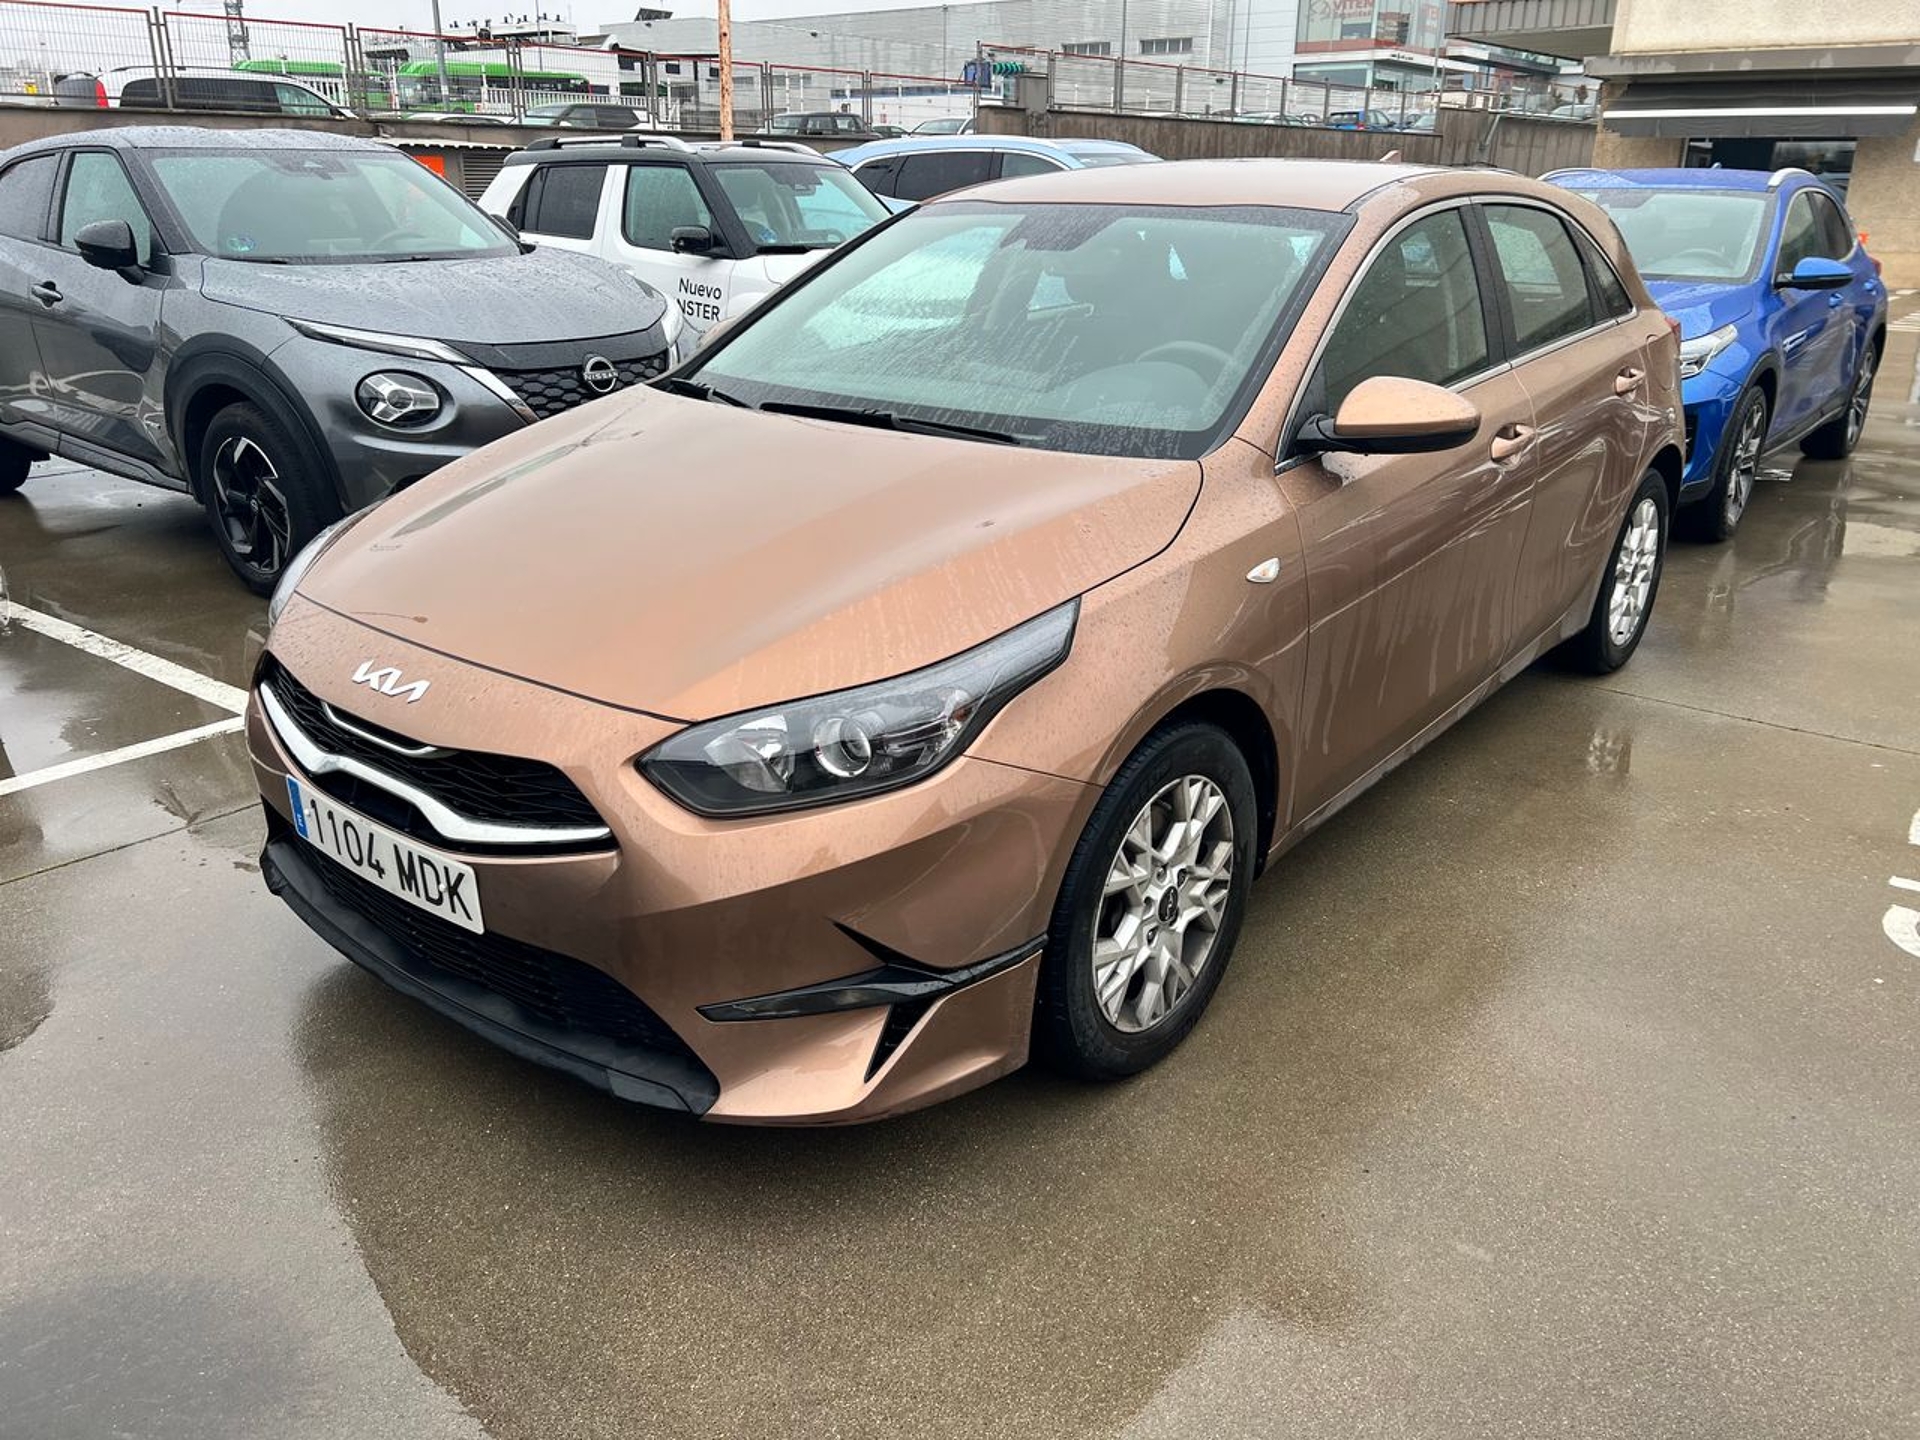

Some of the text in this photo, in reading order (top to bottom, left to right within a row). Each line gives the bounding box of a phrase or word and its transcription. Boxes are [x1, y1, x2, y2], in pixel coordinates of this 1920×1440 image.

[679, 277, 722, 300] Nuevo
[676, 298, 720, 321] NSTER
[584, 370, 618, 381] NISSAN
[352, 659, 431, 704] KIA
[310, 798, 473, 922] 1104 MDK
